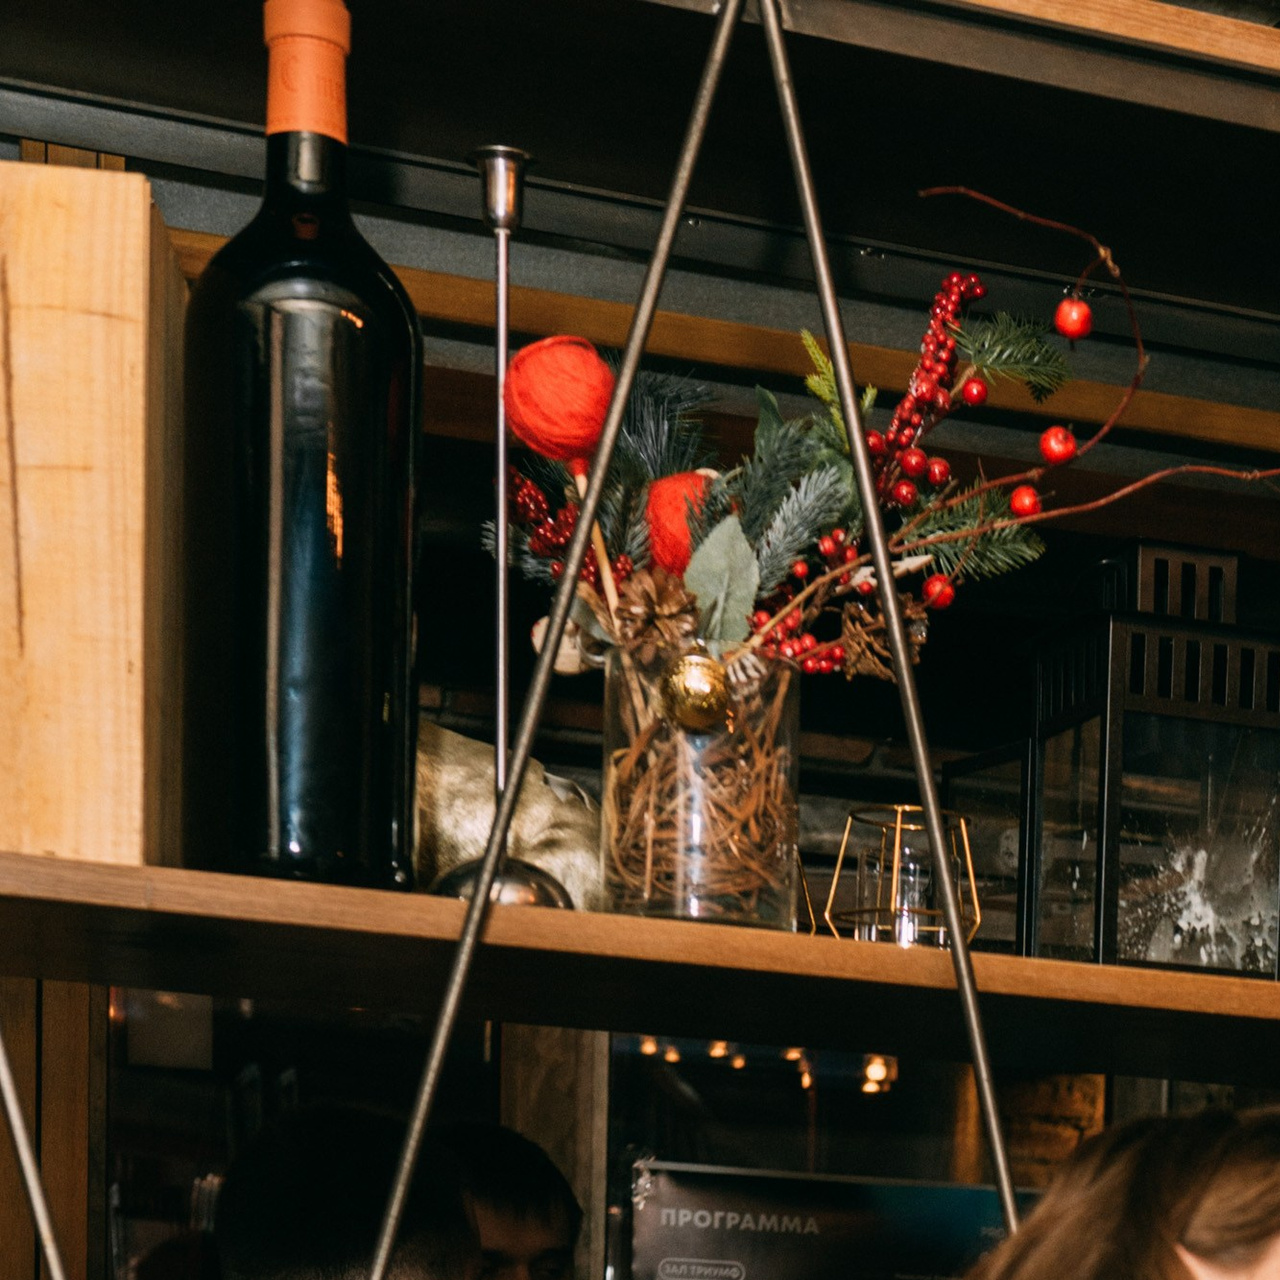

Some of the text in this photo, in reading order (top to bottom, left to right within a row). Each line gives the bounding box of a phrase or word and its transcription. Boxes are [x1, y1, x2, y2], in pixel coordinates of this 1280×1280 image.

[660, 1207, 820, 1235] ПРОГРАММА
[664, 1263, 741, 1279] ЗАЛ ТРИУМФ
